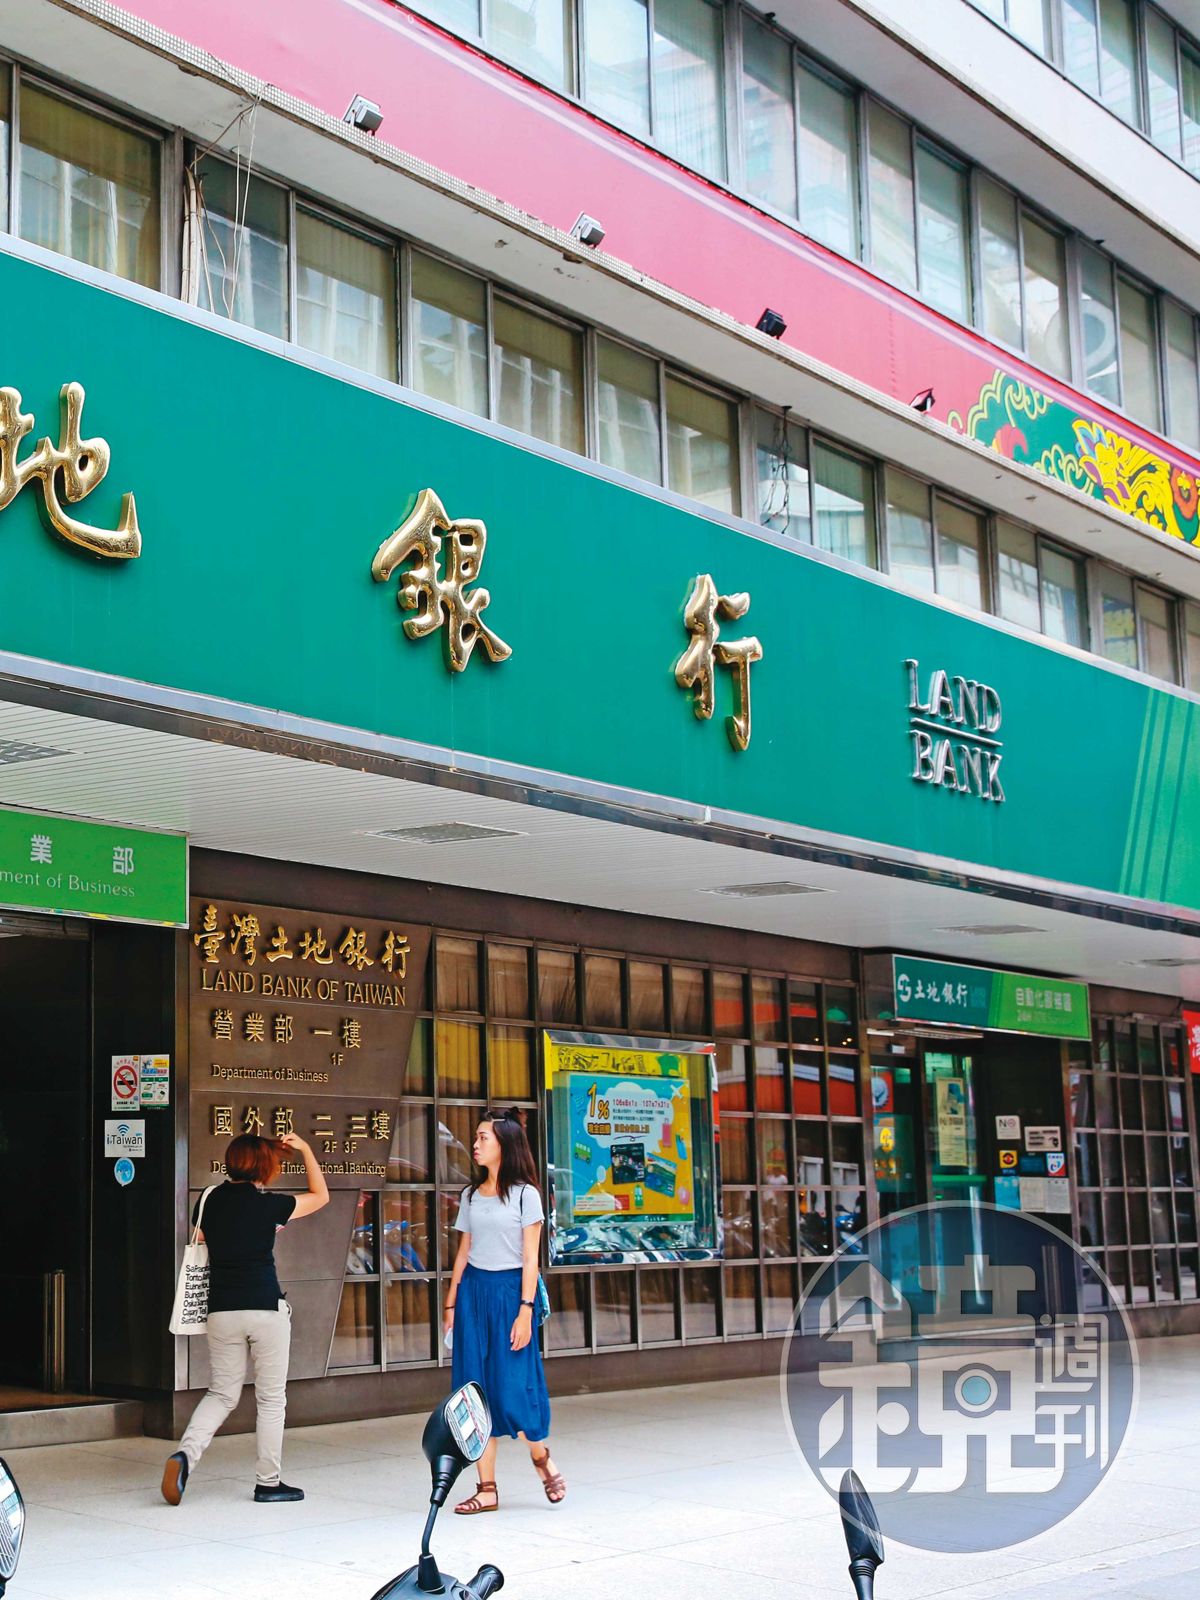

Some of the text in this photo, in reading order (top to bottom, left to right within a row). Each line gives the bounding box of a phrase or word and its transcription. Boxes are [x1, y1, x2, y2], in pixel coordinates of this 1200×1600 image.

[903, 658, 1002, 733] LAND
[907, 729, 1006, 802] BANK
[46, 871, 62, 888] of
[68, 875, 136, 898] Business
[193, 904, 411, 979] 臺灣土地銀行
[202, 968, 406, 1007] LAND BANK OF TAIWAN
[213, 1009, 362, 1049] 營業部 一樓
[213, 1064, 329, 1083] Department of Business
[331, 1053, 344, 1066] 1F
[214, 1106, 294, 1137] 國外部
[324, 1141, 357, 1154] 2F 3F
[350, 1163, 386, 1178] Banking
